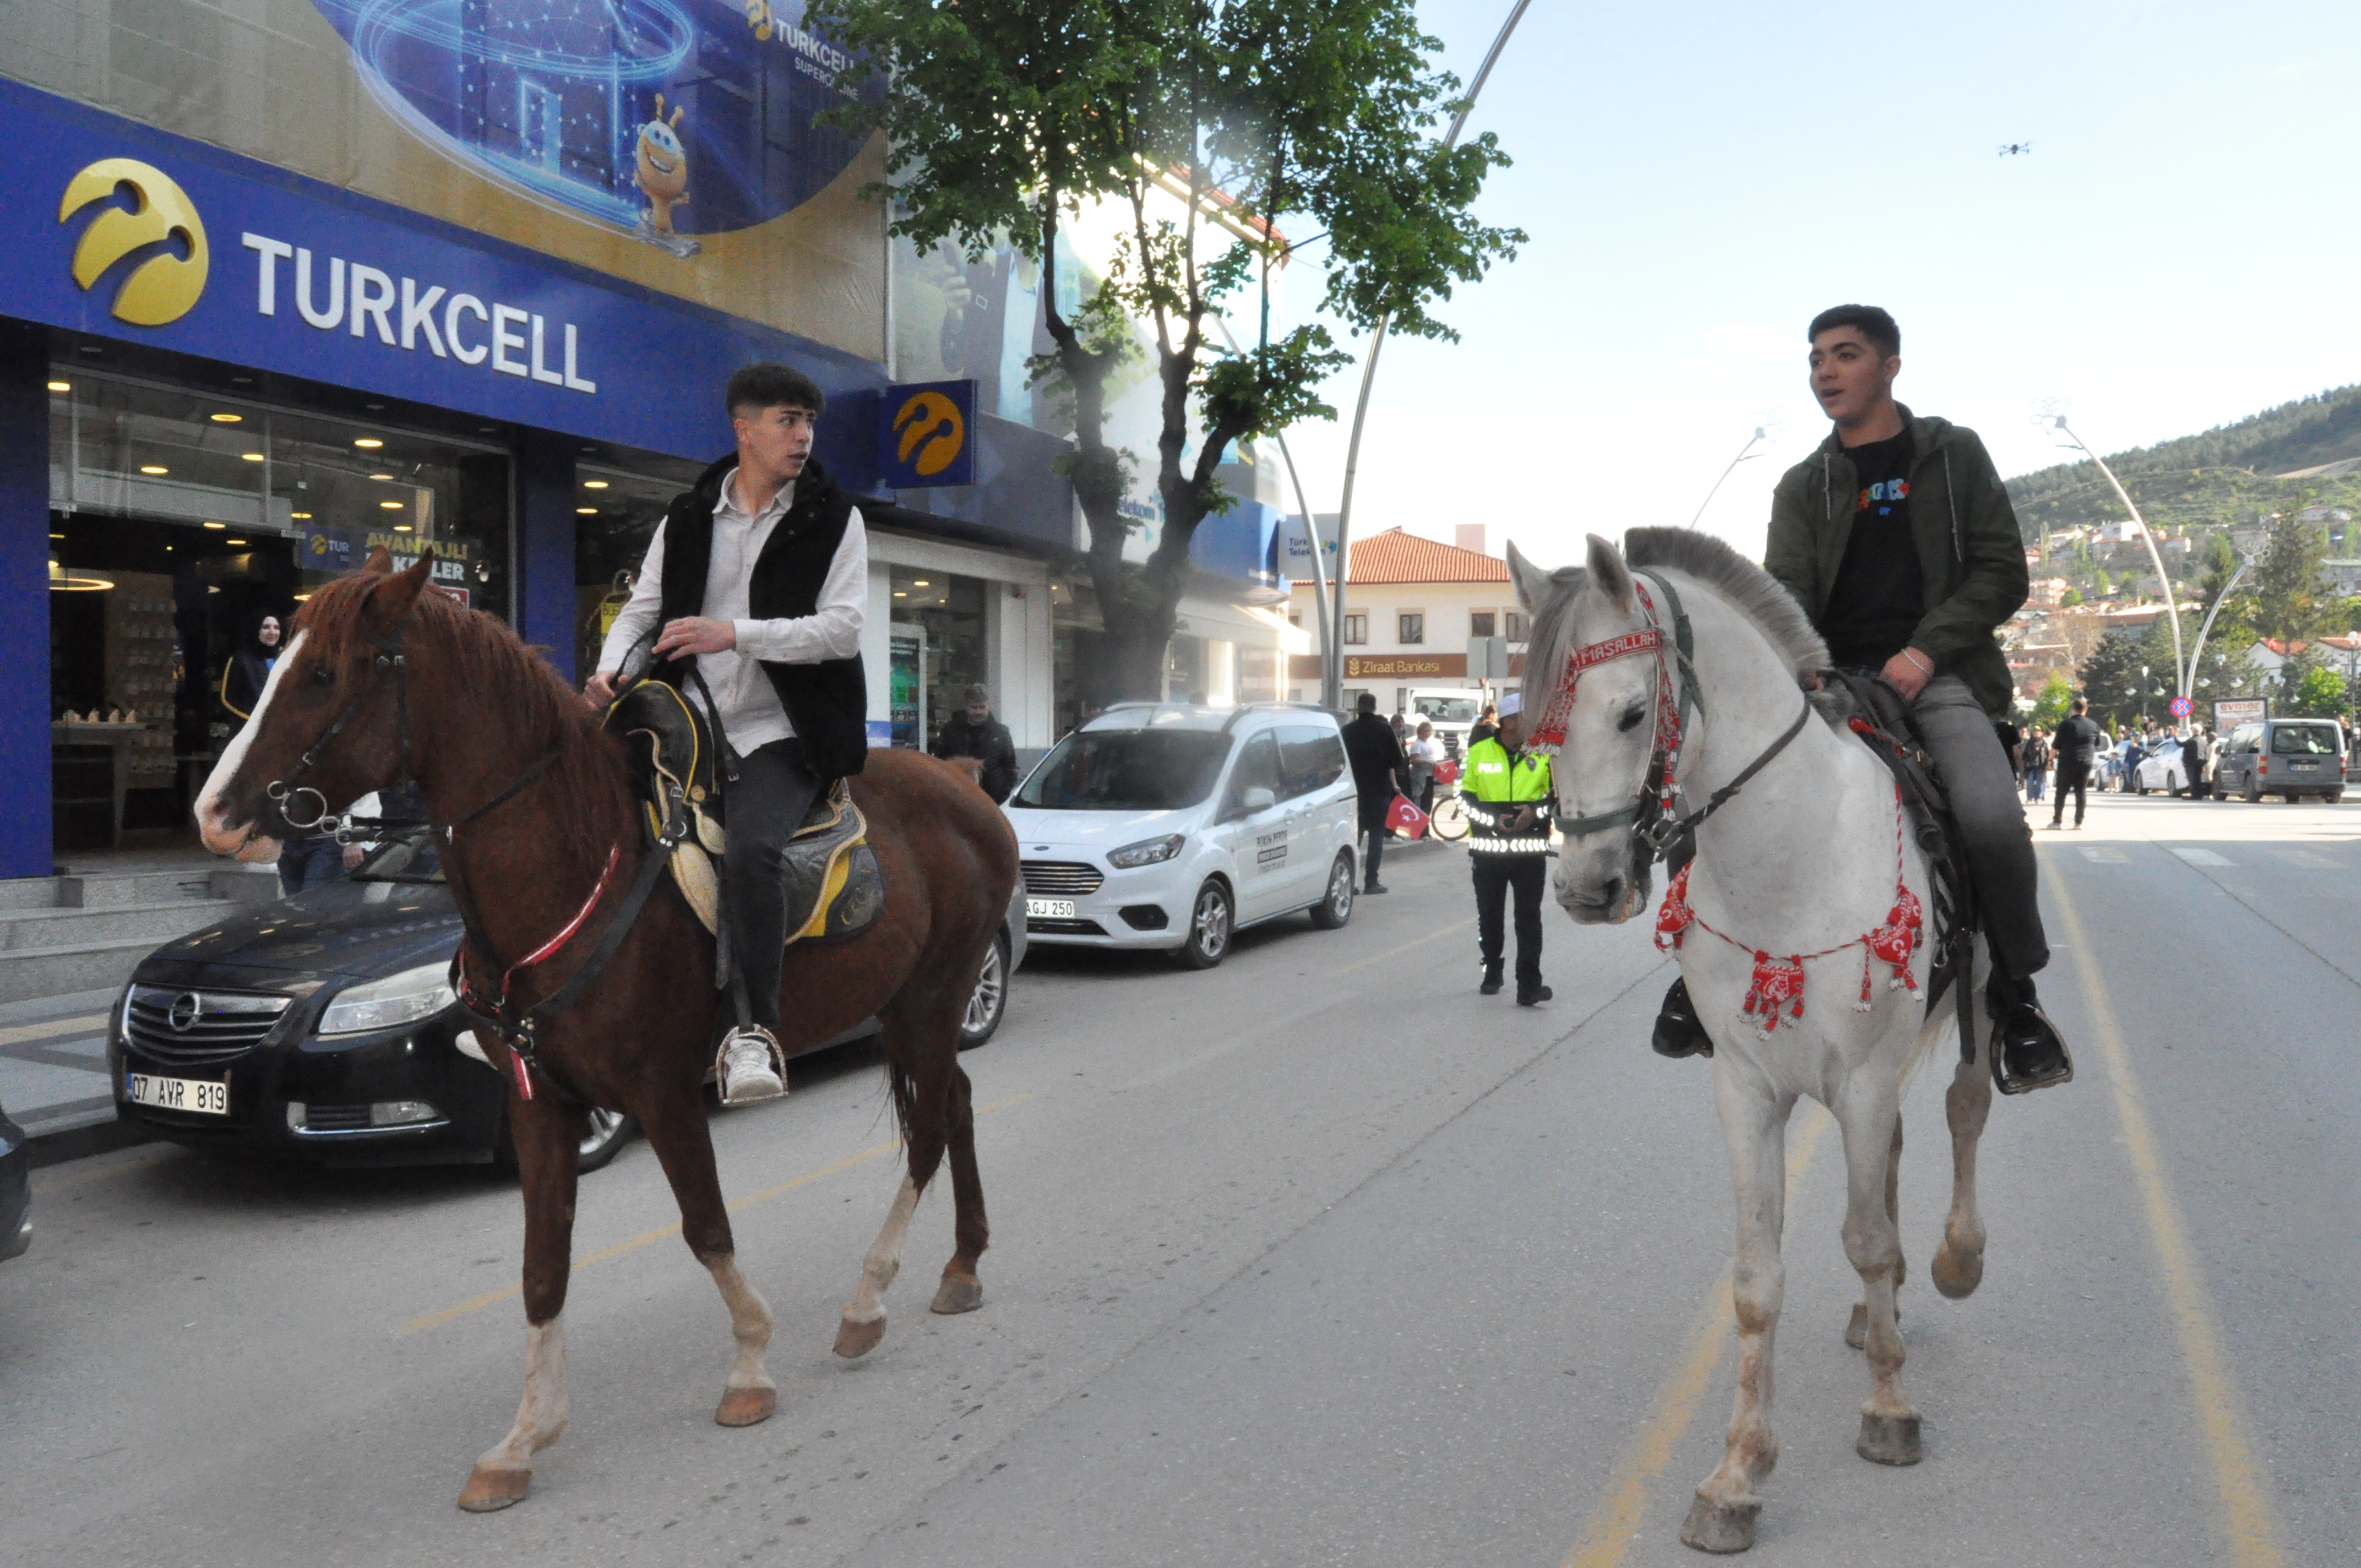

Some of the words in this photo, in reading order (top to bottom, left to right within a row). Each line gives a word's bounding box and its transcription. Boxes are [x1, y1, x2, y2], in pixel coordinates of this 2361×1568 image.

[241, 231, 596, 394] TURKCELL
[1289, 538, 1308, 546] Türk
[1362, 662, 1396, 673] Ziraat
[1397, 661, 1440, 673] Bankası
[1052, 902, 1073, 916] 250
[133, 1076, 148, 1101] 07
[159, 1079, 184, 1107] AVR
[197, 1084, 225, 1110] 819
